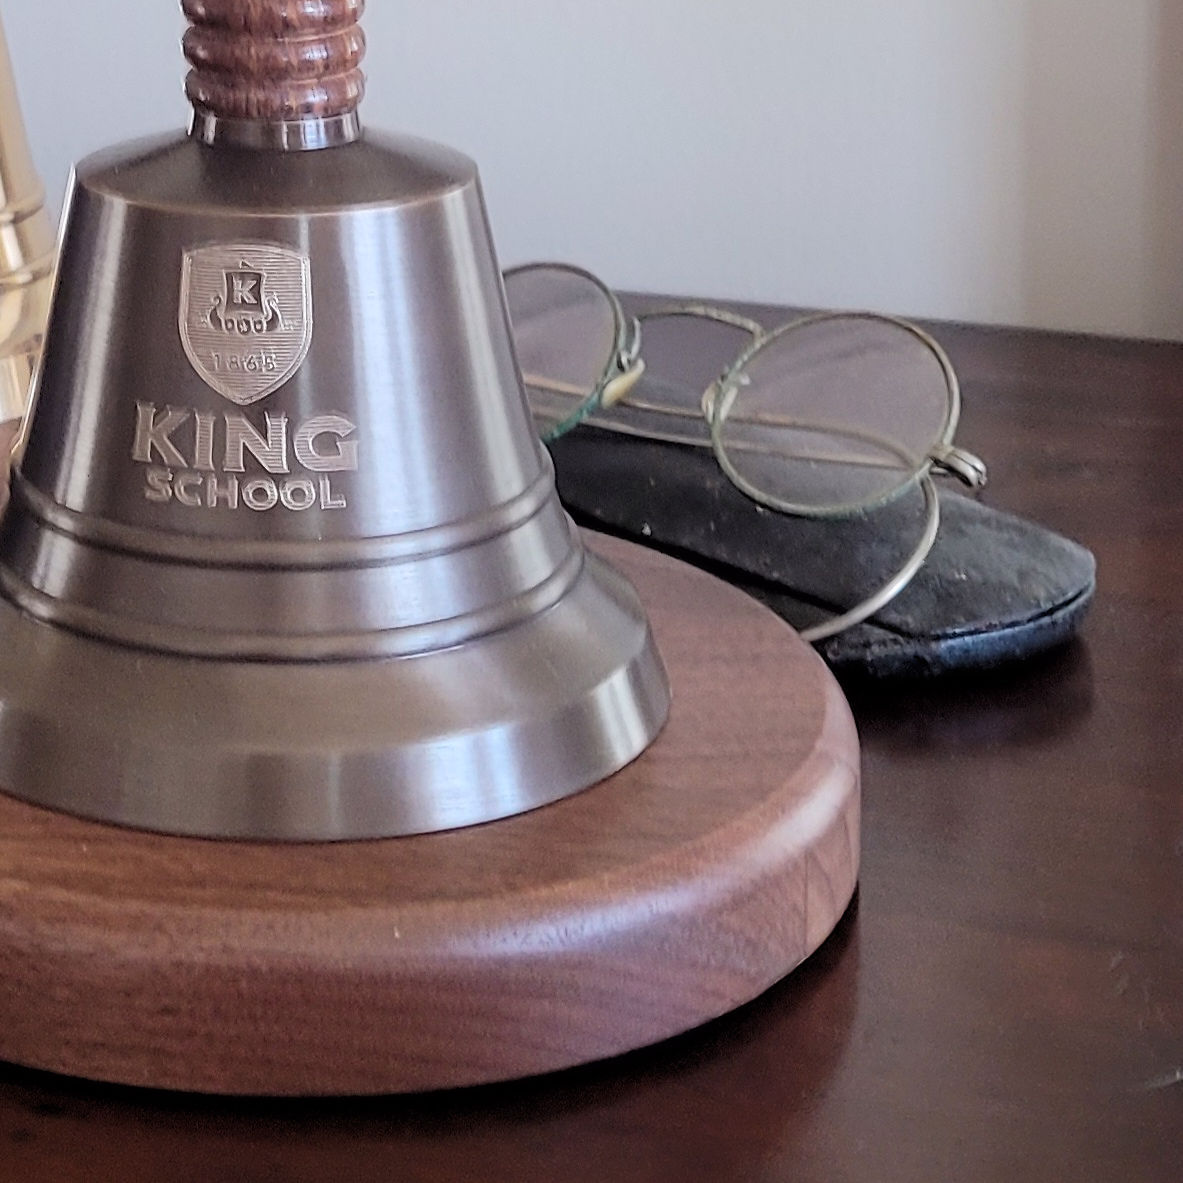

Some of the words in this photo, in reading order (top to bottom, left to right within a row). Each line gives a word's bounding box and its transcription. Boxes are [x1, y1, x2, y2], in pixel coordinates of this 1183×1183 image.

[232, 274, 258, 305] K
[132, 402, 358, 472] KING
[145, 469, 346, 510] SCHOOL
